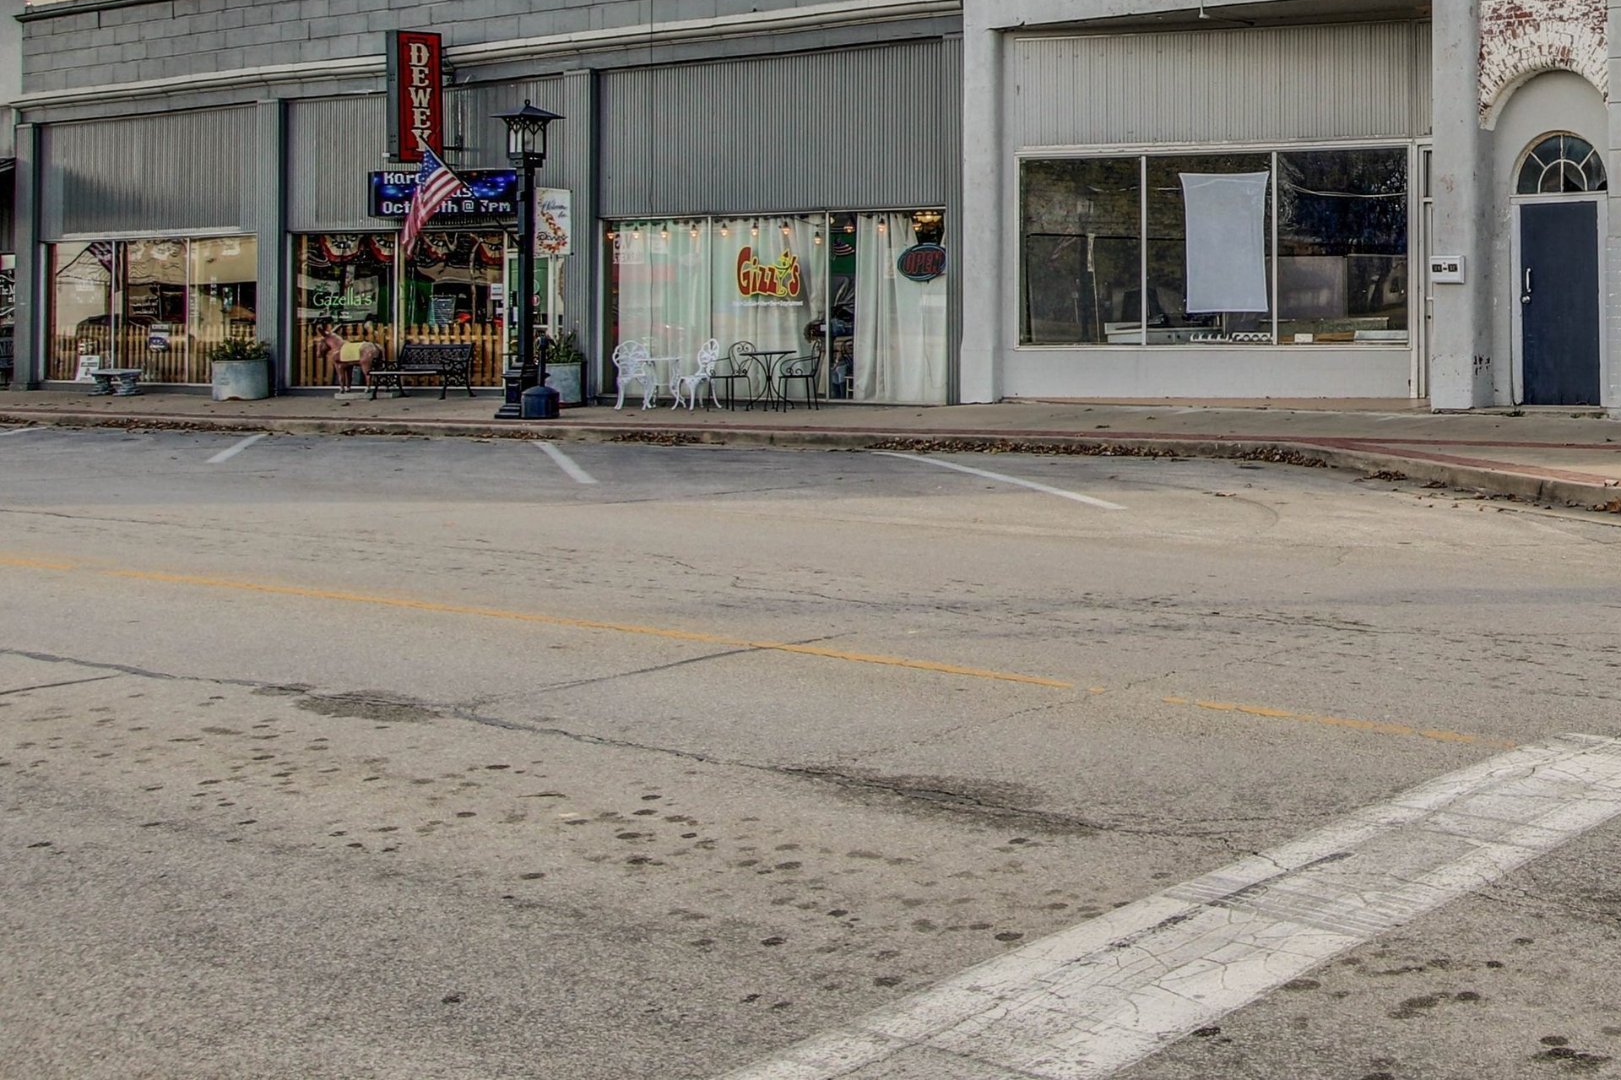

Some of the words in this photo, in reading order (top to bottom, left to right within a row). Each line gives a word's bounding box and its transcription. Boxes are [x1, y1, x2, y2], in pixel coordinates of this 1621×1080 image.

[408, 42, 432, 152] DEWEY
[904, 251, 943, 274] OPEN
[313, 287, 373, 307] Gazella's
